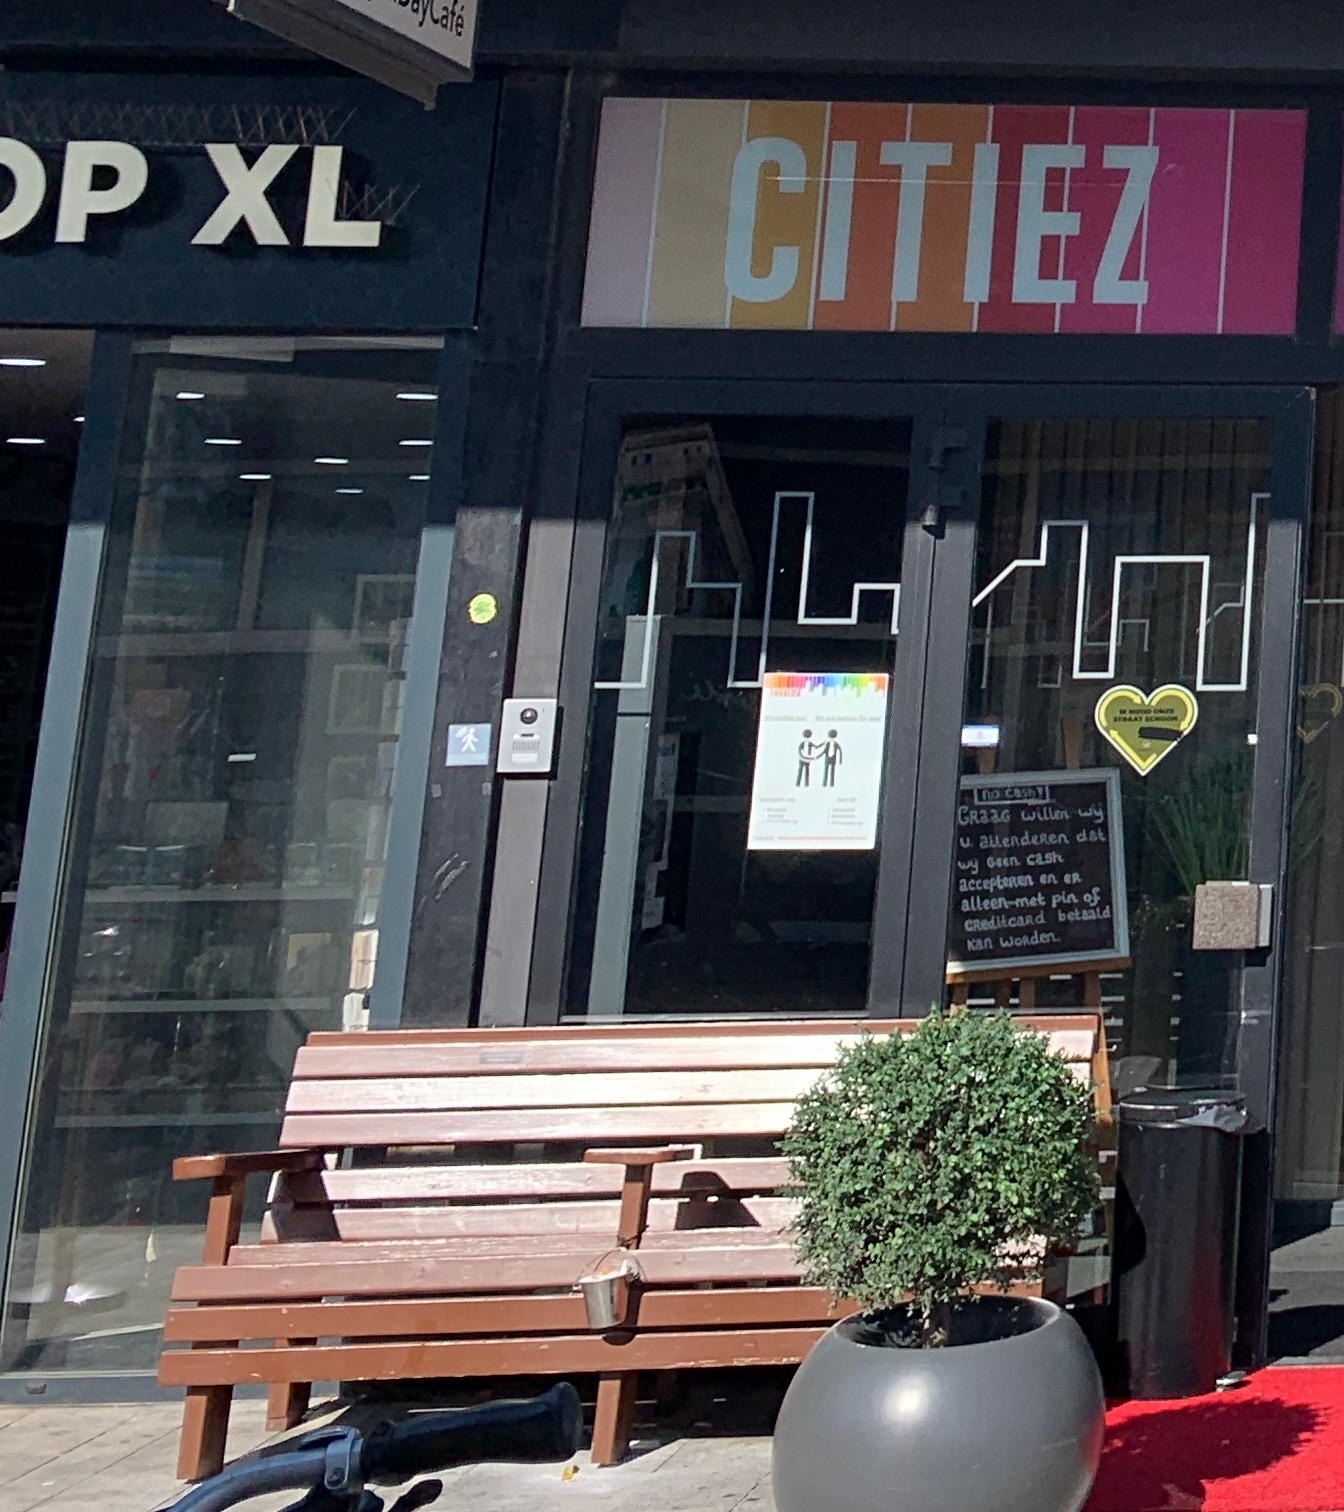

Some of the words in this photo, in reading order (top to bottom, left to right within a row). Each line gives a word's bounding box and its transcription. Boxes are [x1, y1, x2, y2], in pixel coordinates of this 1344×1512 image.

[190, 143, 382, 248] XL
[723, 136, 1160, 305] CITIEZ
[1026, 850, 1065, 867] cash
[1039, 872, 1059, 886] en
[1051, 890, 1079, 909] pin
[1083, 886, 1102, 907] of
[1057, 904, 1112, 923] betaald
